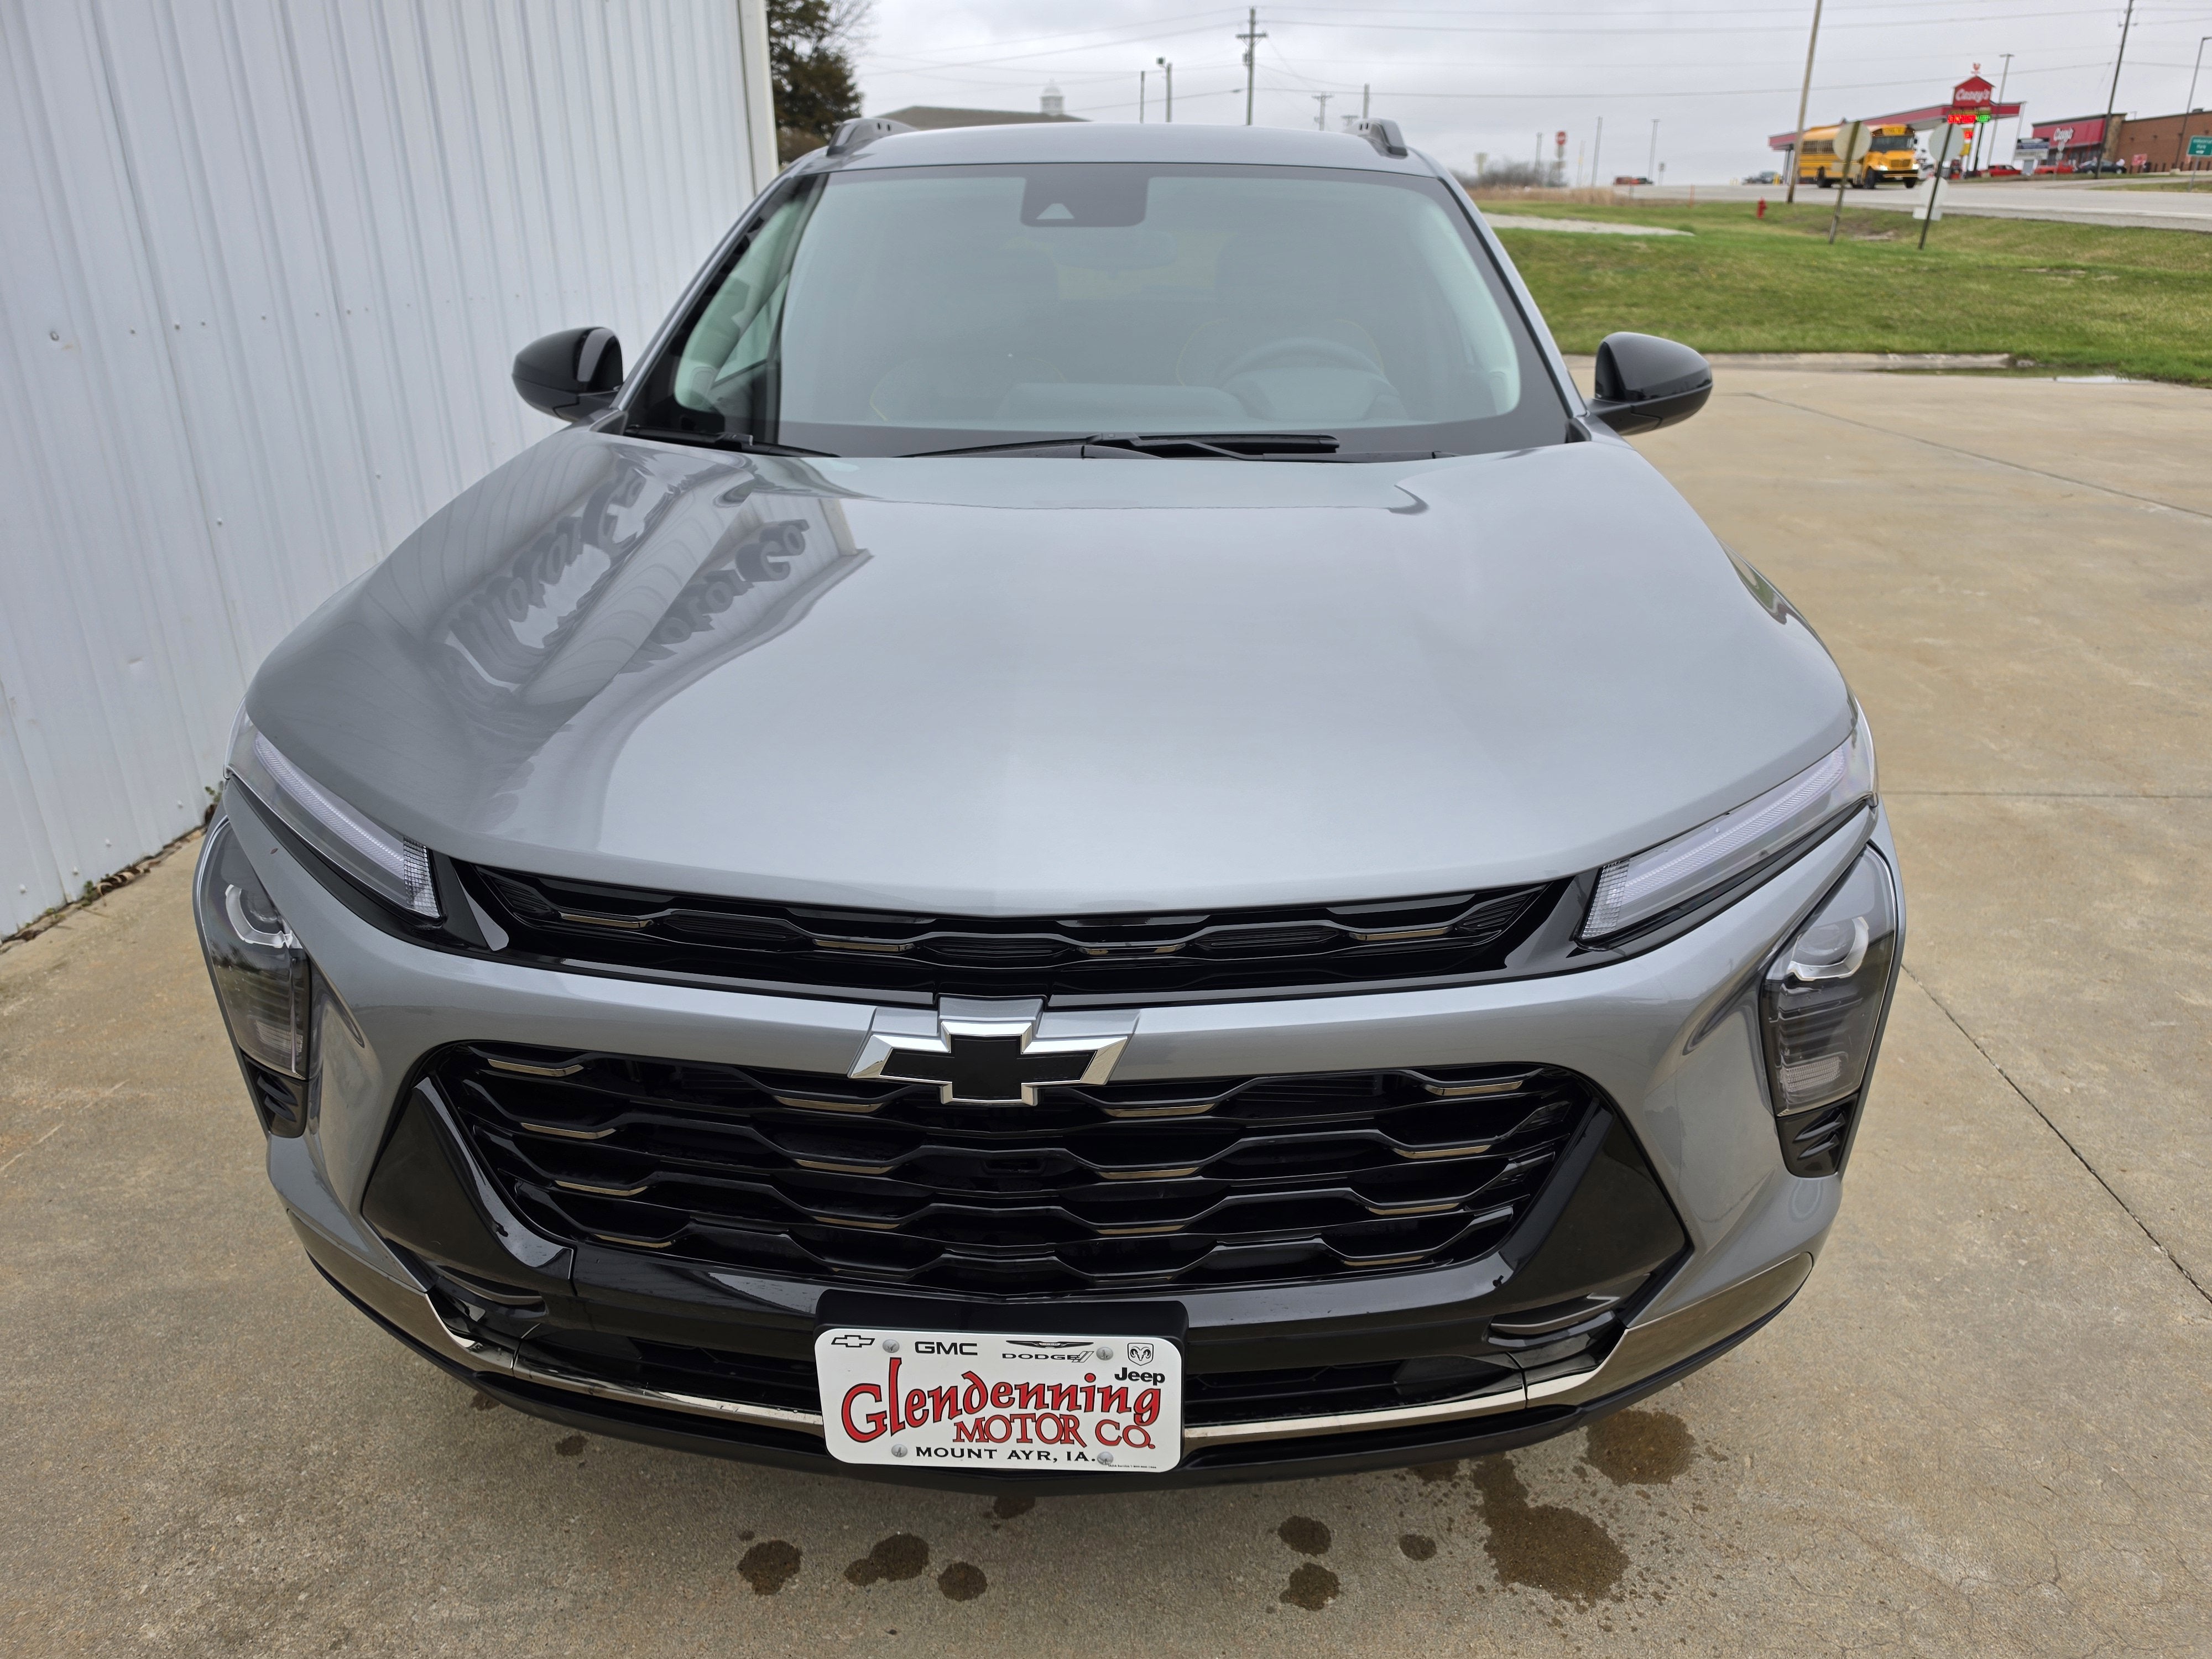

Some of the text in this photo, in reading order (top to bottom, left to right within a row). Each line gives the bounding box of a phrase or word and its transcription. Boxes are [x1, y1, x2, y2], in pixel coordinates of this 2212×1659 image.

[915, 1341, 978, 1356] GMC
[1114, 1368, 1166, 1386] Jeep
[841, 1357, 1161, 1443] Glendenning
[952, 1412, 1156, 1449] MOTOR CO.
[916, 1446, 1096, 1463] MOUNT AYR, IA.
